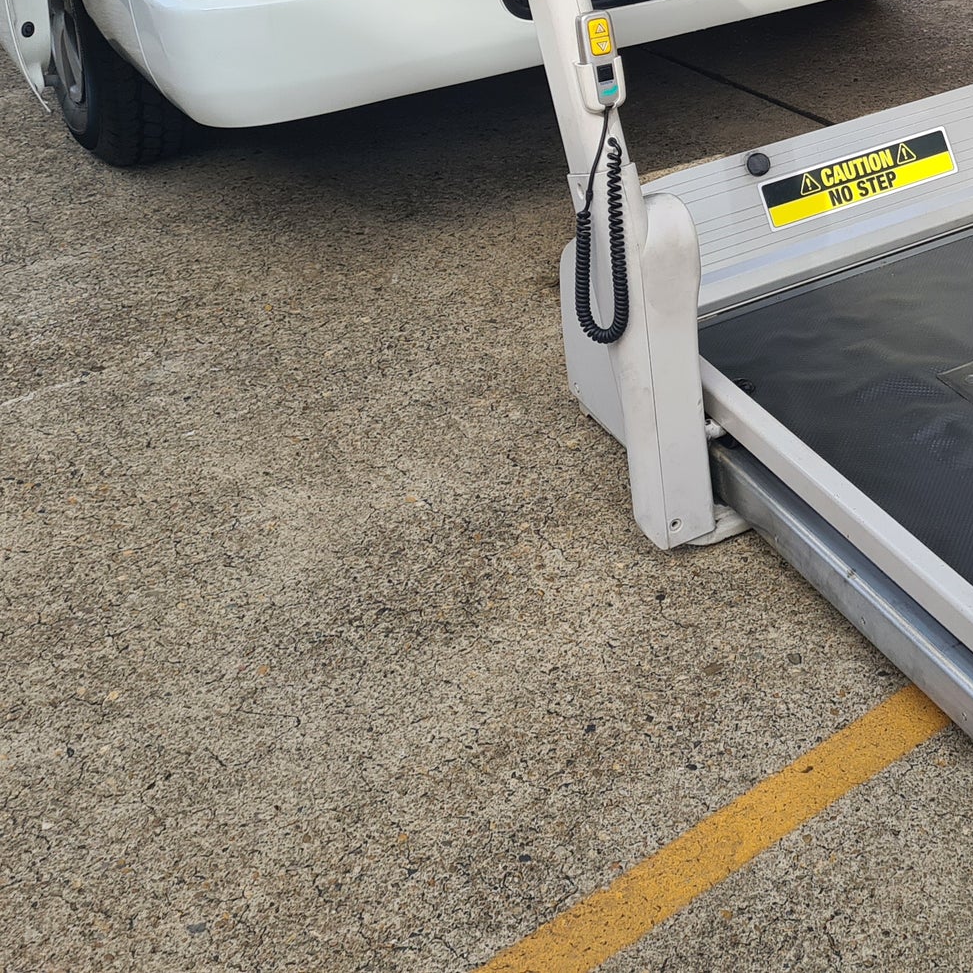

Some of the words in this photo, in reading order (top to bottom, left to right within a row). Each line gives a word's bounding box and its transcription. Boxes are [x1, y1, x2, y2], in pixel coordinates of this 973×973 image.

[820, 149, 894, 187] CAUTION
[829, 185, 853, 207] NO
[856, 171, 897, 198] STEP
